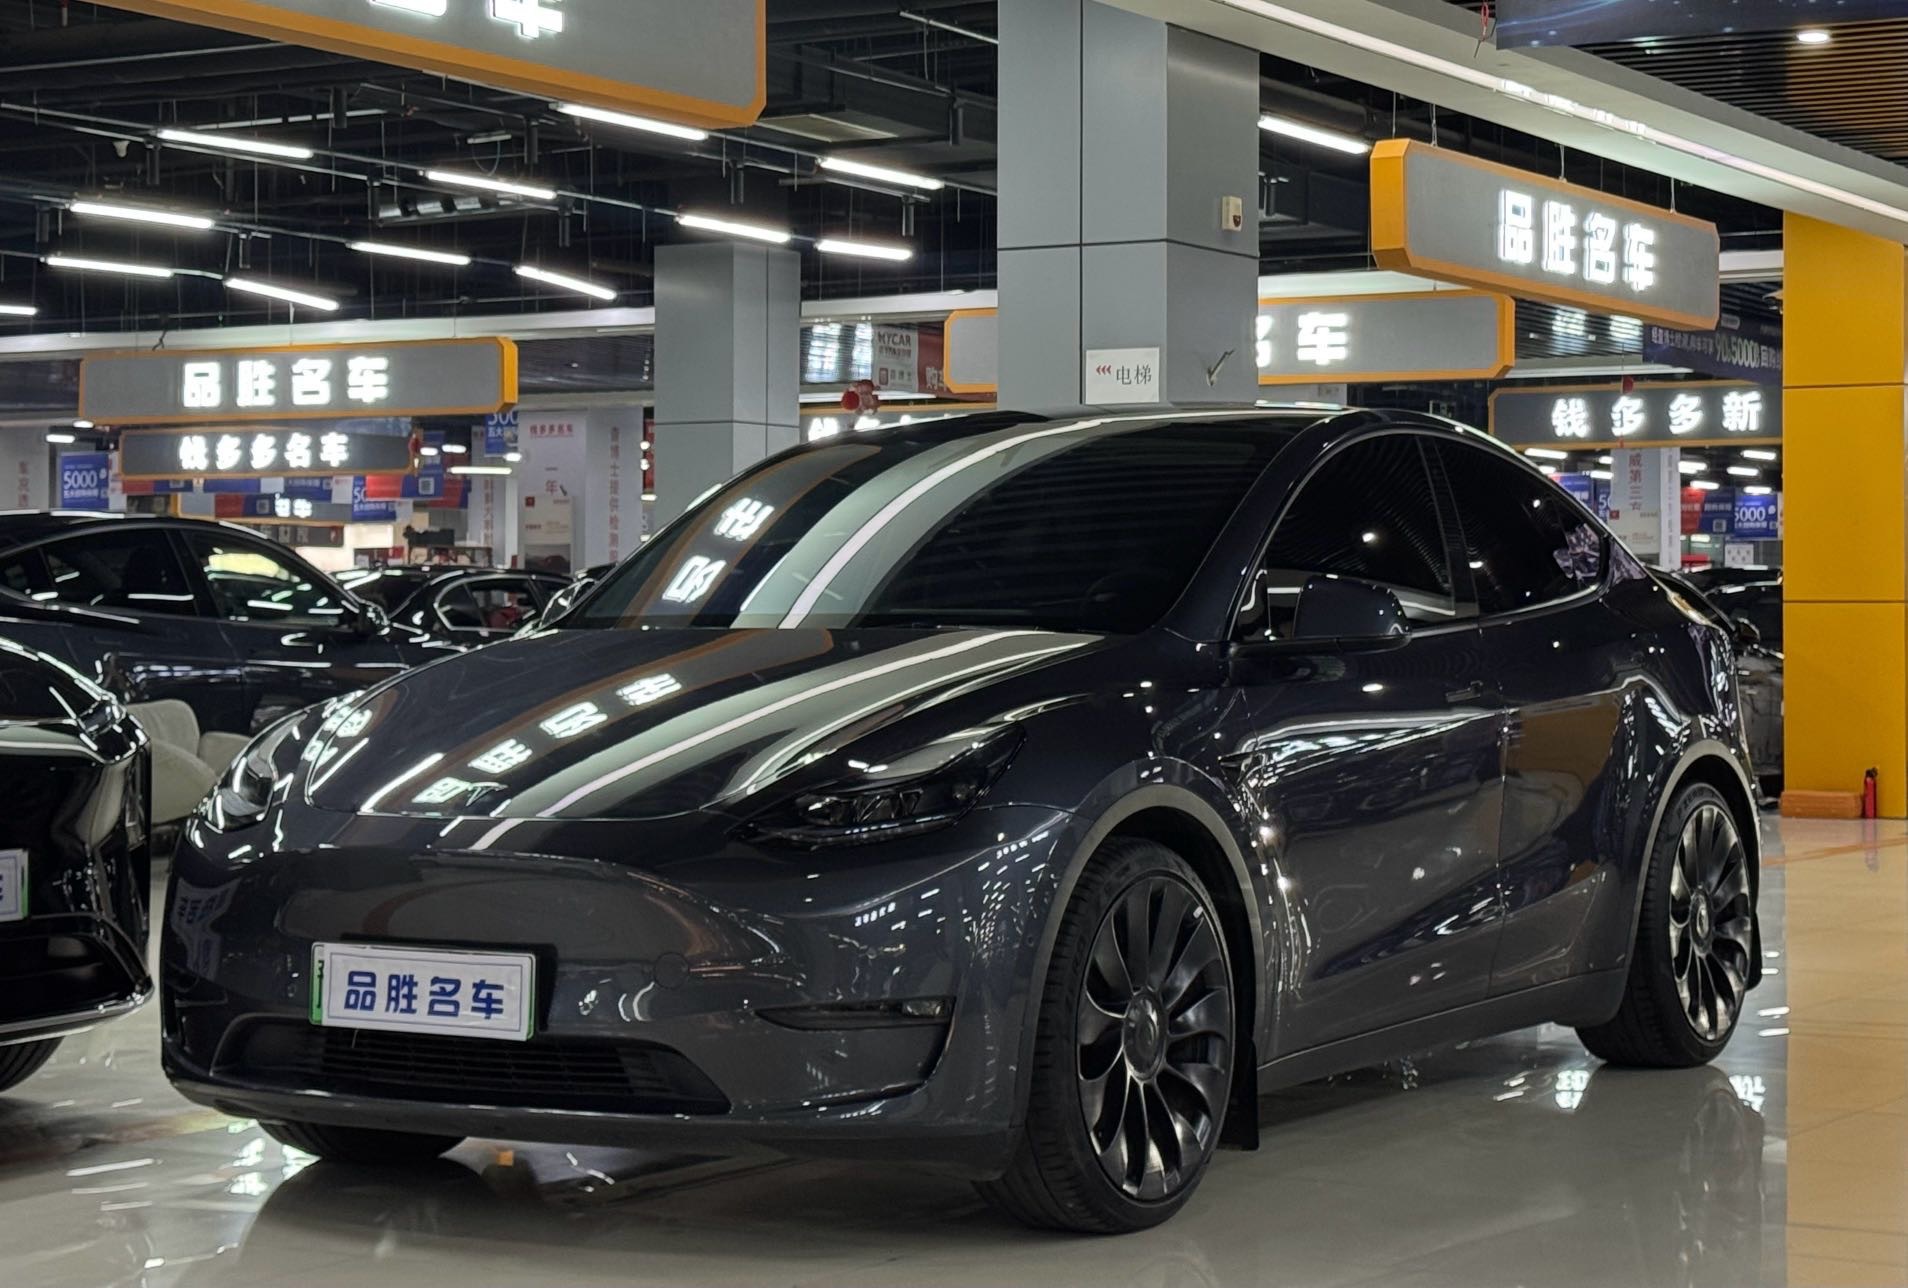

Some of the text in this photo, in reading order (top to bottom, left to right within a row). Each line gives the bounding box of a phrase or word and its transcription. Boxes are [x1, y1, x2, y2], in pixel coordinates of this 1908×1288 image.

[1498, 188, 1655, 291] 品胜名车
[183, 356, 389, 408] 品胜名车
[1116, 364, 1152, 385] 电梯
[1551, 391, 1762, 438] 钱多多新
[179, 432, 349, 470] 钱多多名车
[63, 471, 98, 489] 5000
[343, 969, 505, 1020] 品胜名车
